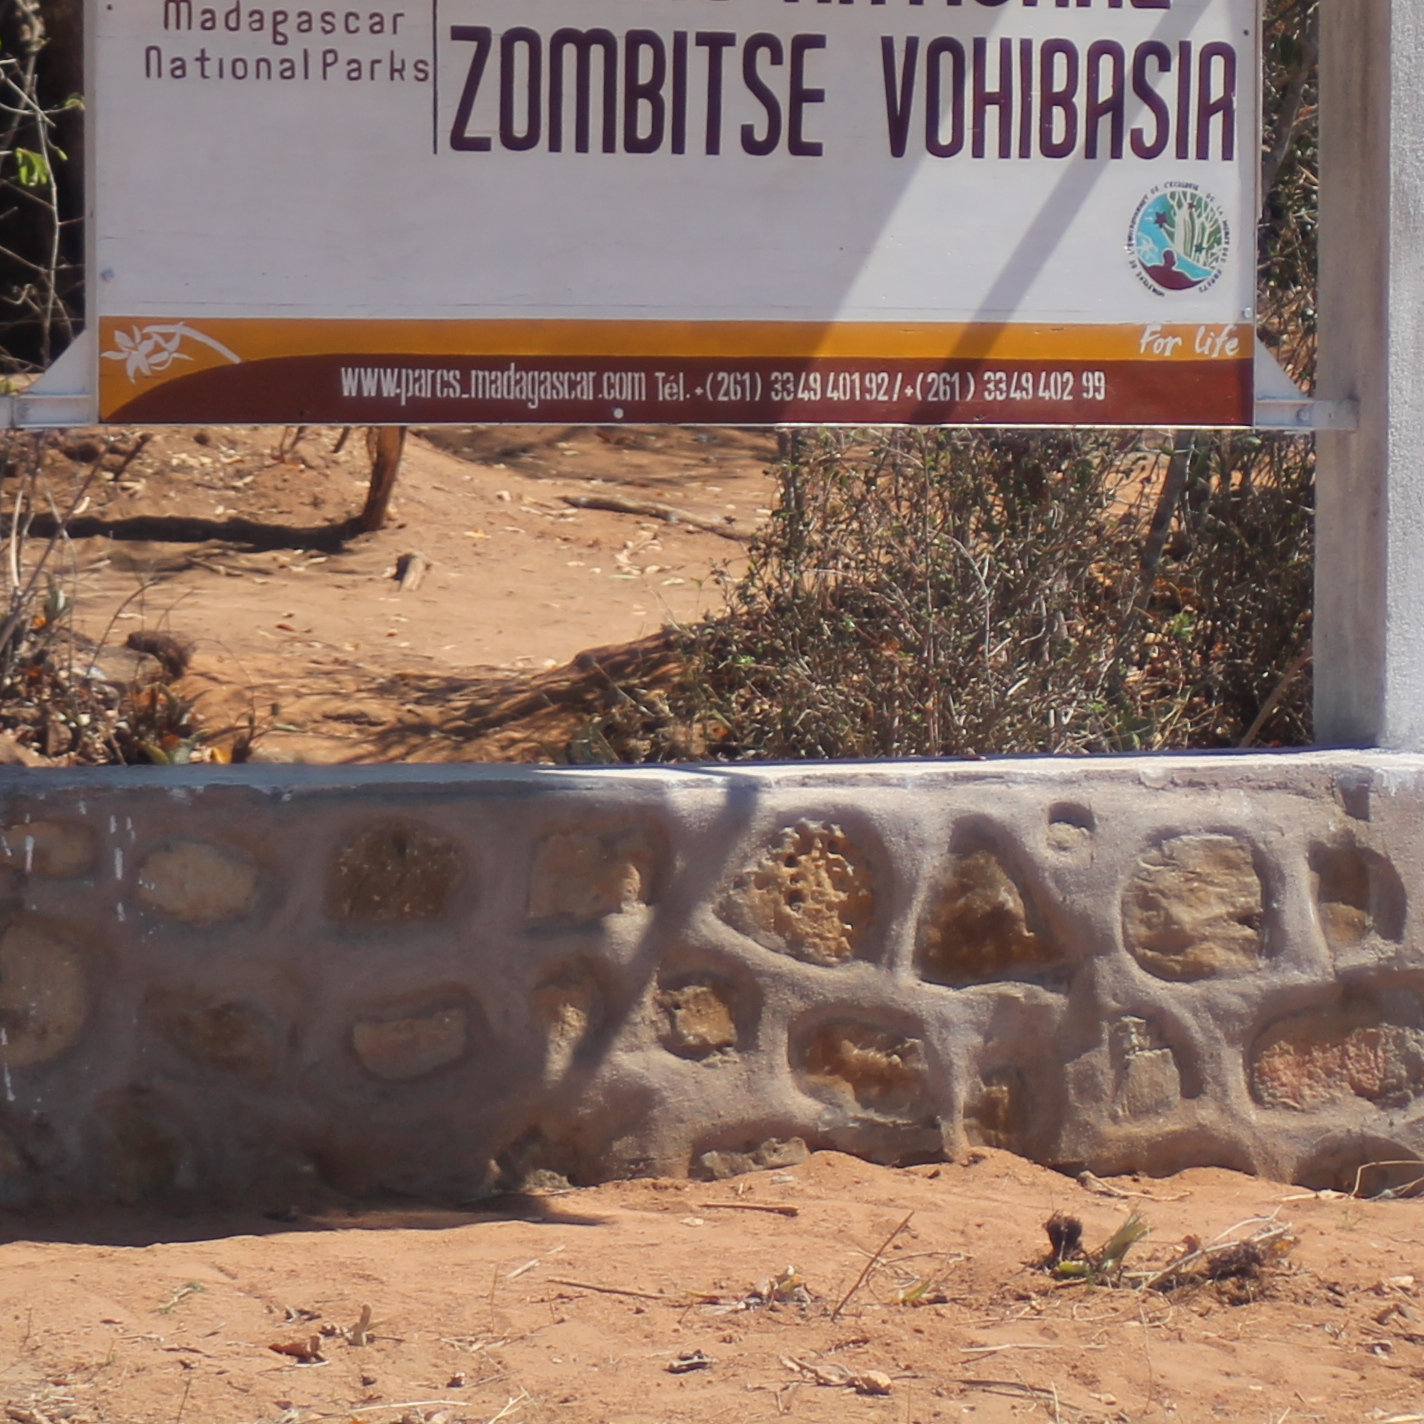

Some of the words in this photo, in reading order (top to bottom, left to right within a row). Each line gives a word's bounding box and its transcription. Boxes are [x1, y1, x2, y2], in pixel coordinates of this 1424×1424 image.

[144, 44, 311, 82] National
[321, 47, 430, 83] Parks
[448, 24, 828, 158] ZOMBITSE
[879, 33, 1239, 161] VOHIBASIA
[1139, 325, 1183, 357] For
[1194, 325, 1240, 359] life
[654, 371, 691, 402] Tél.
[1081, 371, 1106, 401] 99
